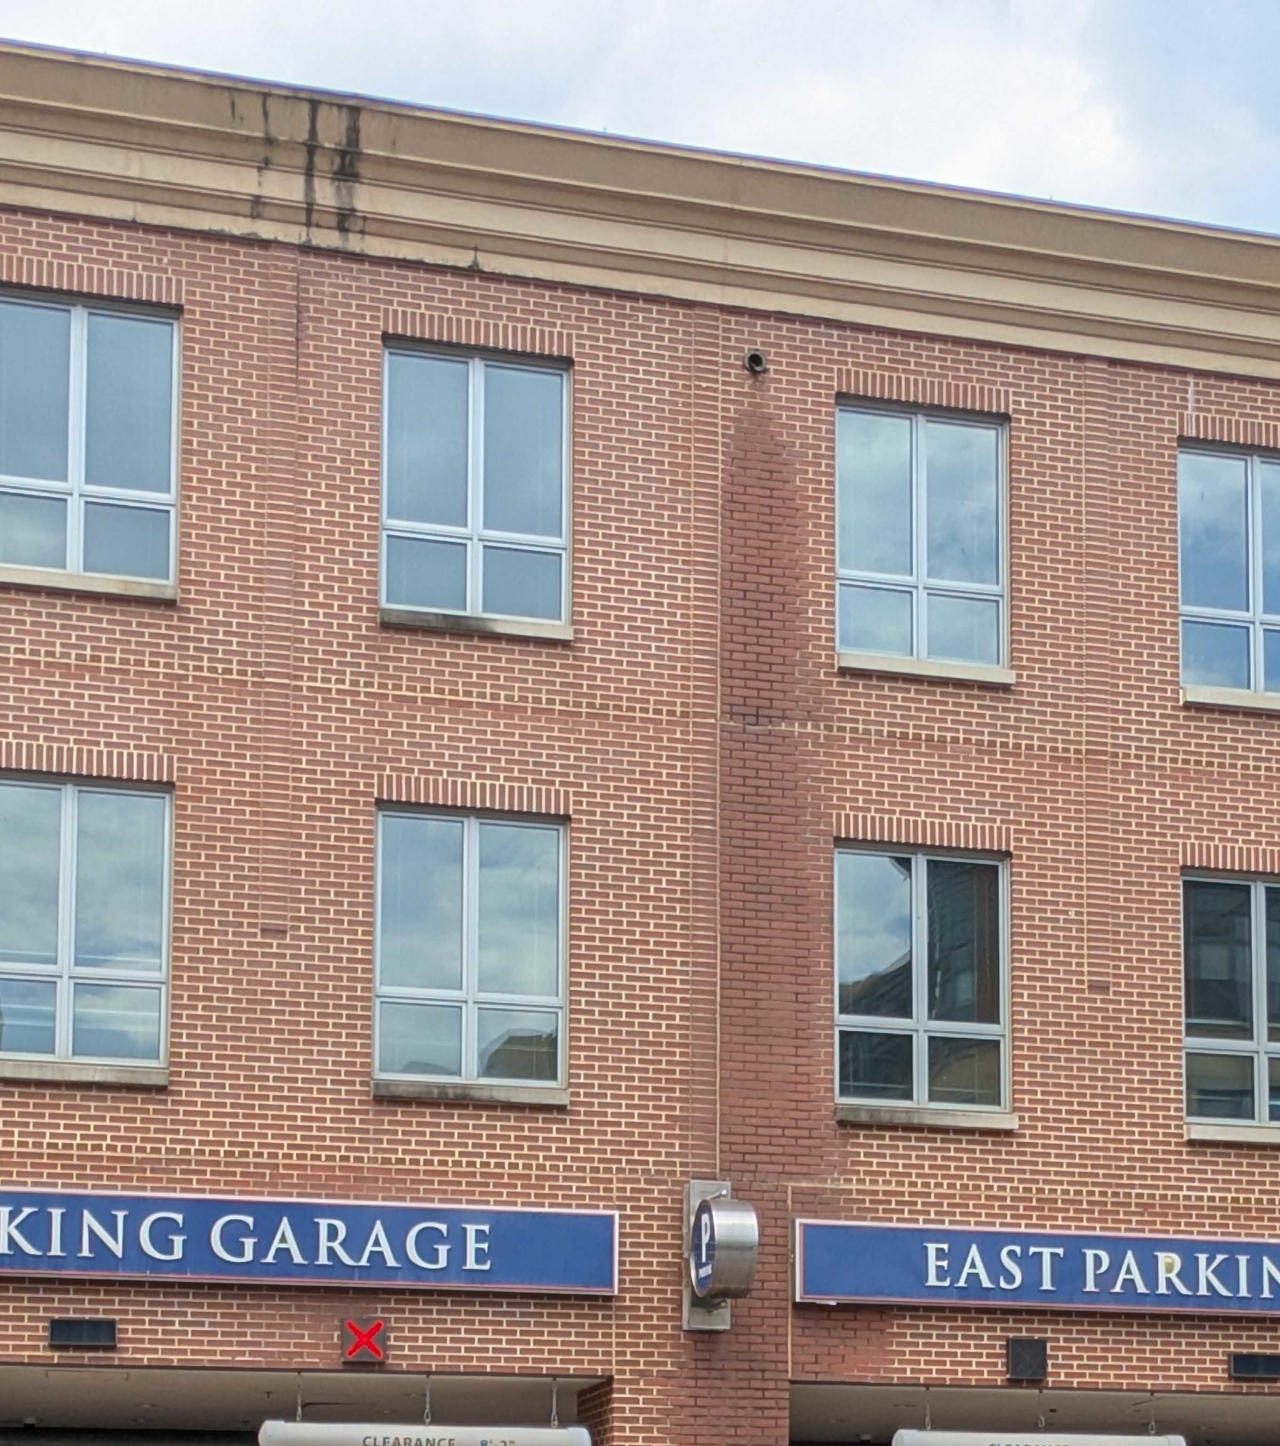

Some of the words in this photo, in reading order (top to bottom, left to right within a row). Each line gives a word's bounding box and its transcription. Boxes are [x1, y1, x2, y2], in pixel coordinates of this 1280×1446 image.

[209, 1213, 492, 1271] GARAGE
[701, 1213, 711, 1263] P
[923, 1242, 1065, 1291] EAST
